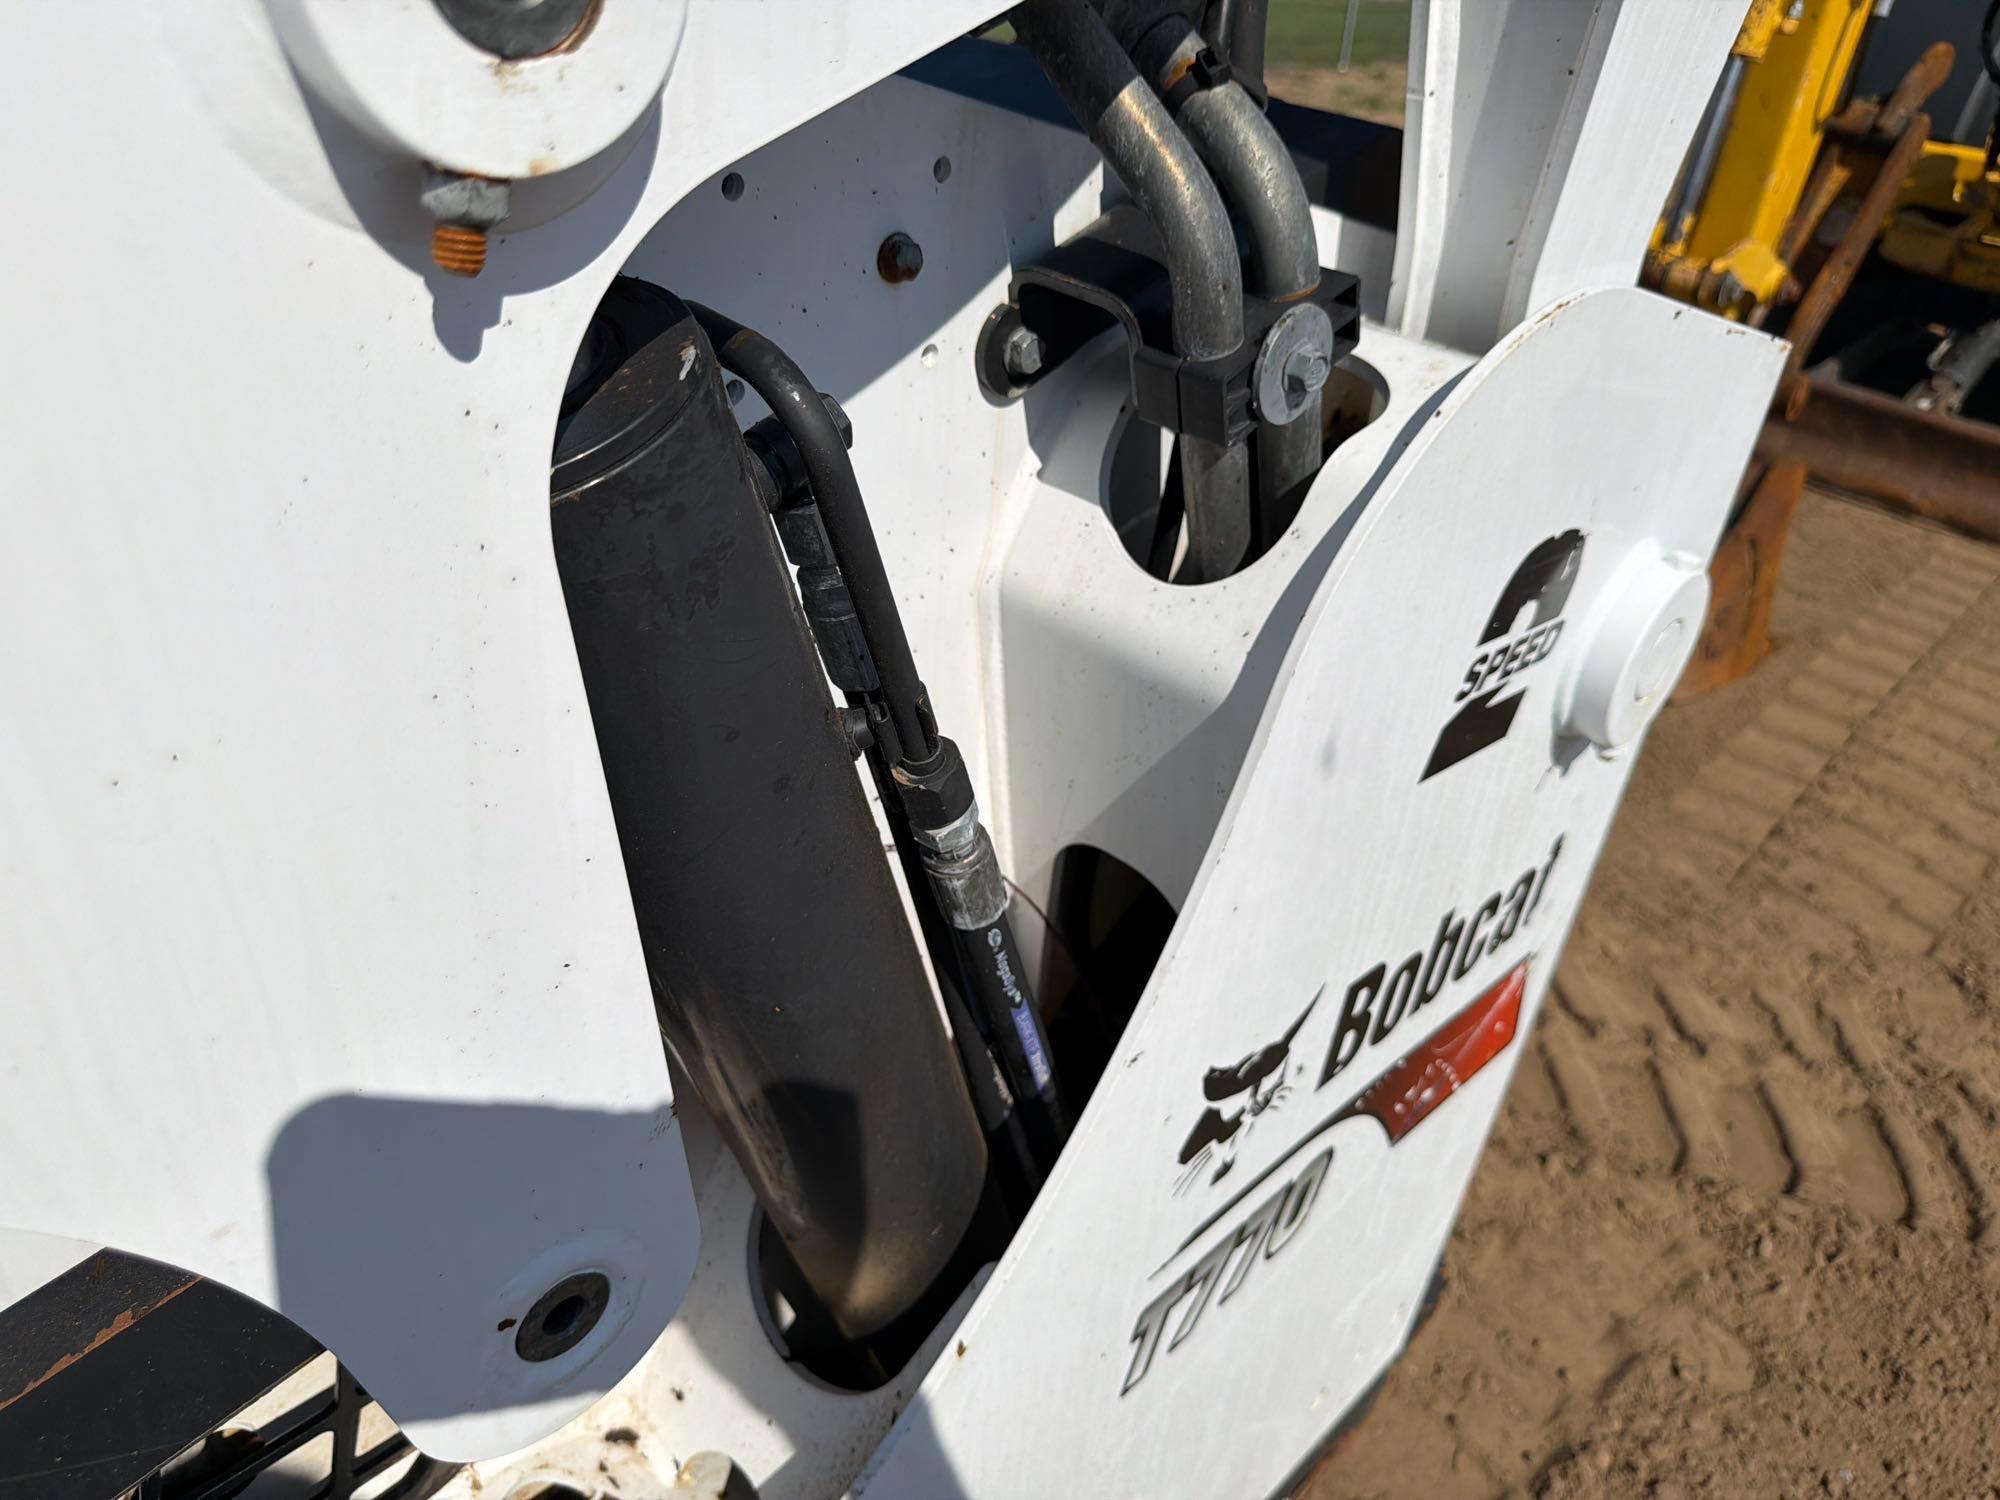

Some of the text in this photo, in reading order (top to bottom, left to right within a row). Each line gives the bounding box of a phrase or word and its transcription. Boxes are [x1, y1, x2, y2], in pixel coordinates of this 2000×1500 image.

[1454, 619, 1566, 702] SPEED
[1314, 832, 1566, 1093] Bobcat
[1119, 1146, 1335, 1398] T770
